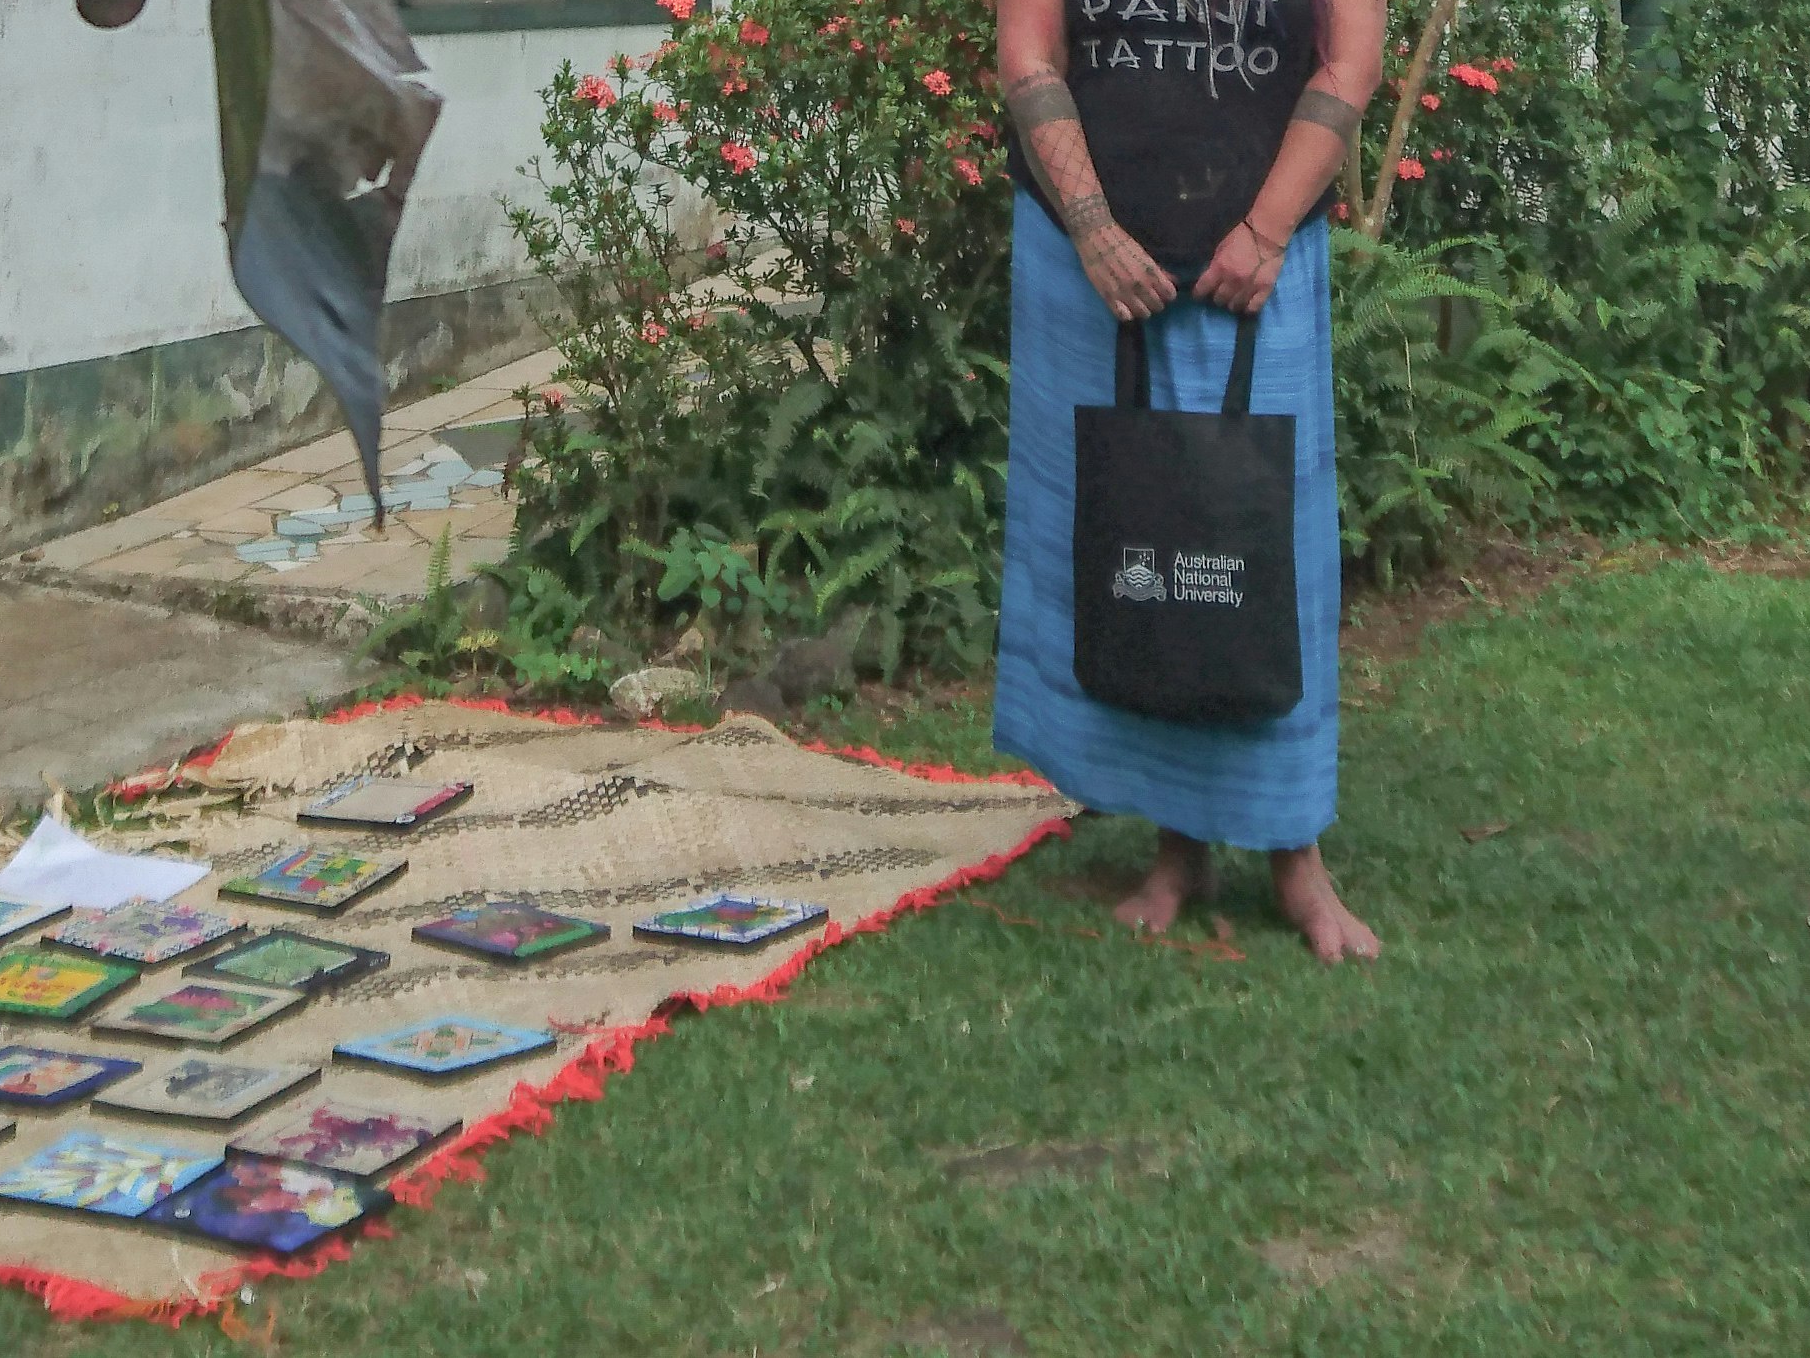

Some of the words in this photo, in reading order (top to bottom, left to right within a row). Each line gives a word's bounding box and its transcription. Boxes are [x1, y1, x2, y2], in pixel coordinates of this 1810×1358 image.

[1083, 37, 1279, 75] TATTOO
[1174, 551, 1245, 571] Australian
[1174, 568, 1232, 587] National
[1174, 584, 1244, 608] University
